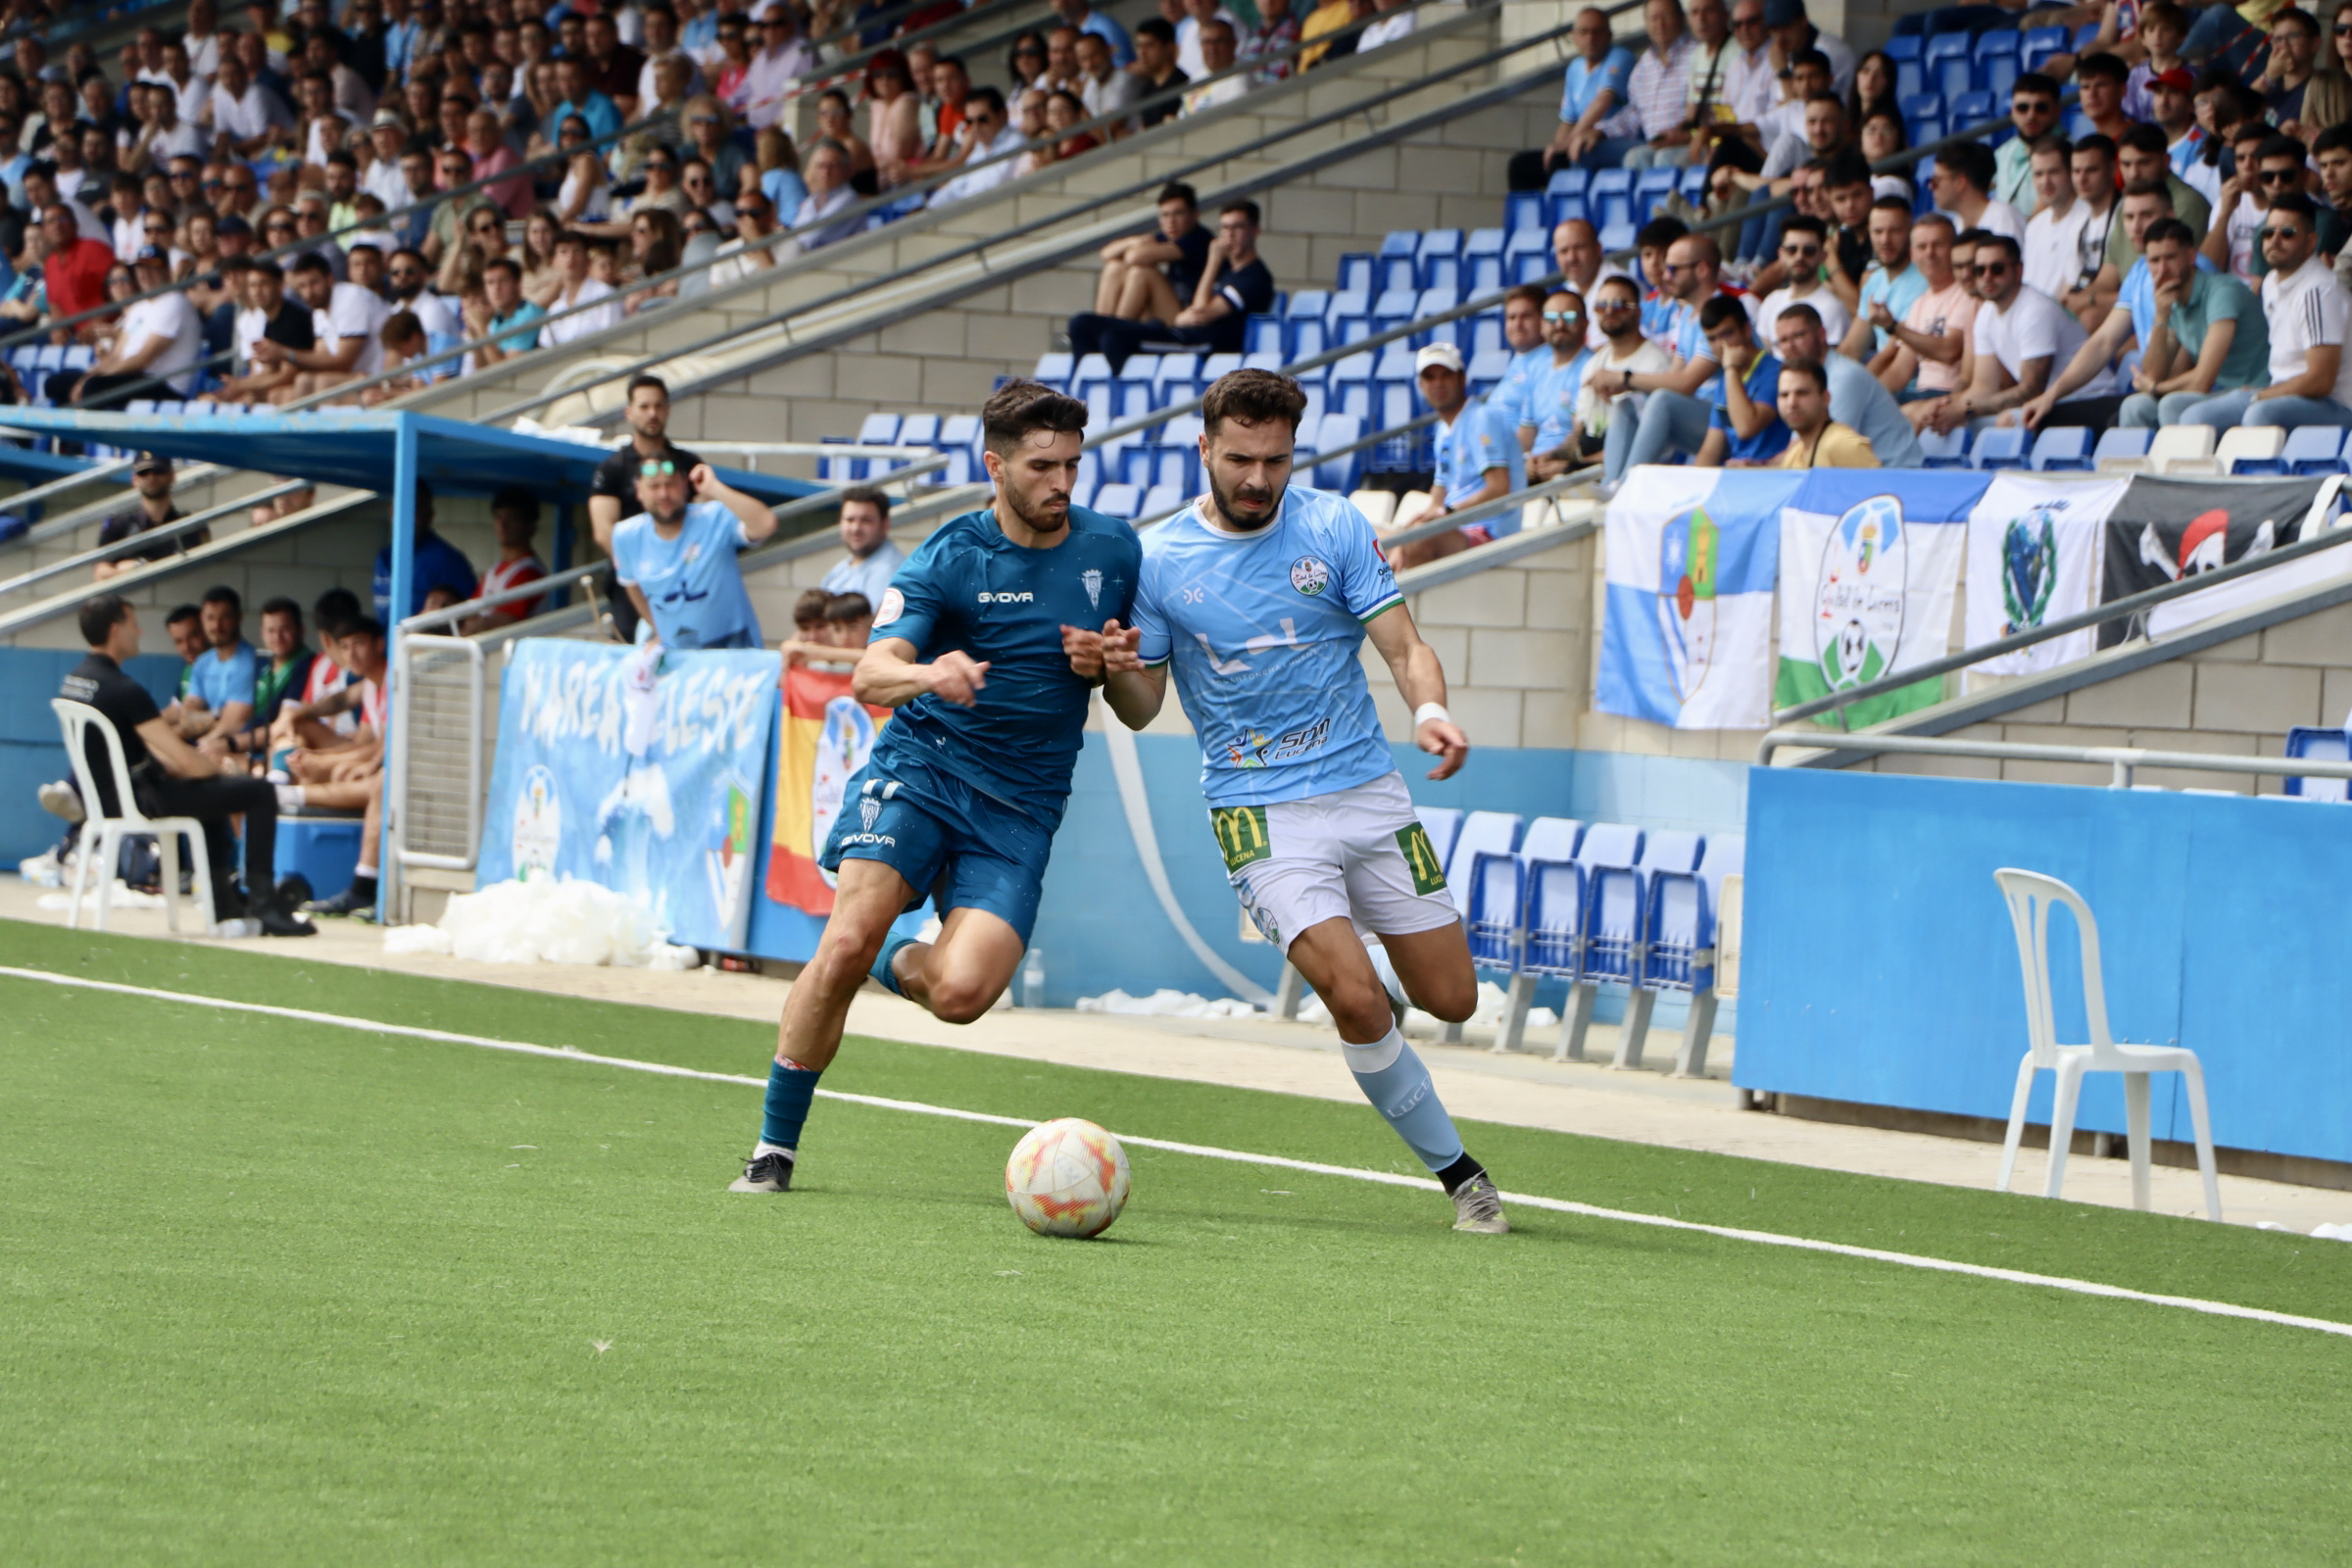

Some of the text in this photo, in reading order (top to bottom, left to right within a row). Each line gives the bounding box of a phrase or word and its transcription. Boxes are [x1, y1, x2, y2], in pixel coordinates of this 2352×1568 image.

[1274, 736, 1328, 760] Lucena
[841, 833, 896, 848] GIVOVA
[1230, 849, 1255, 867] LUCENA
